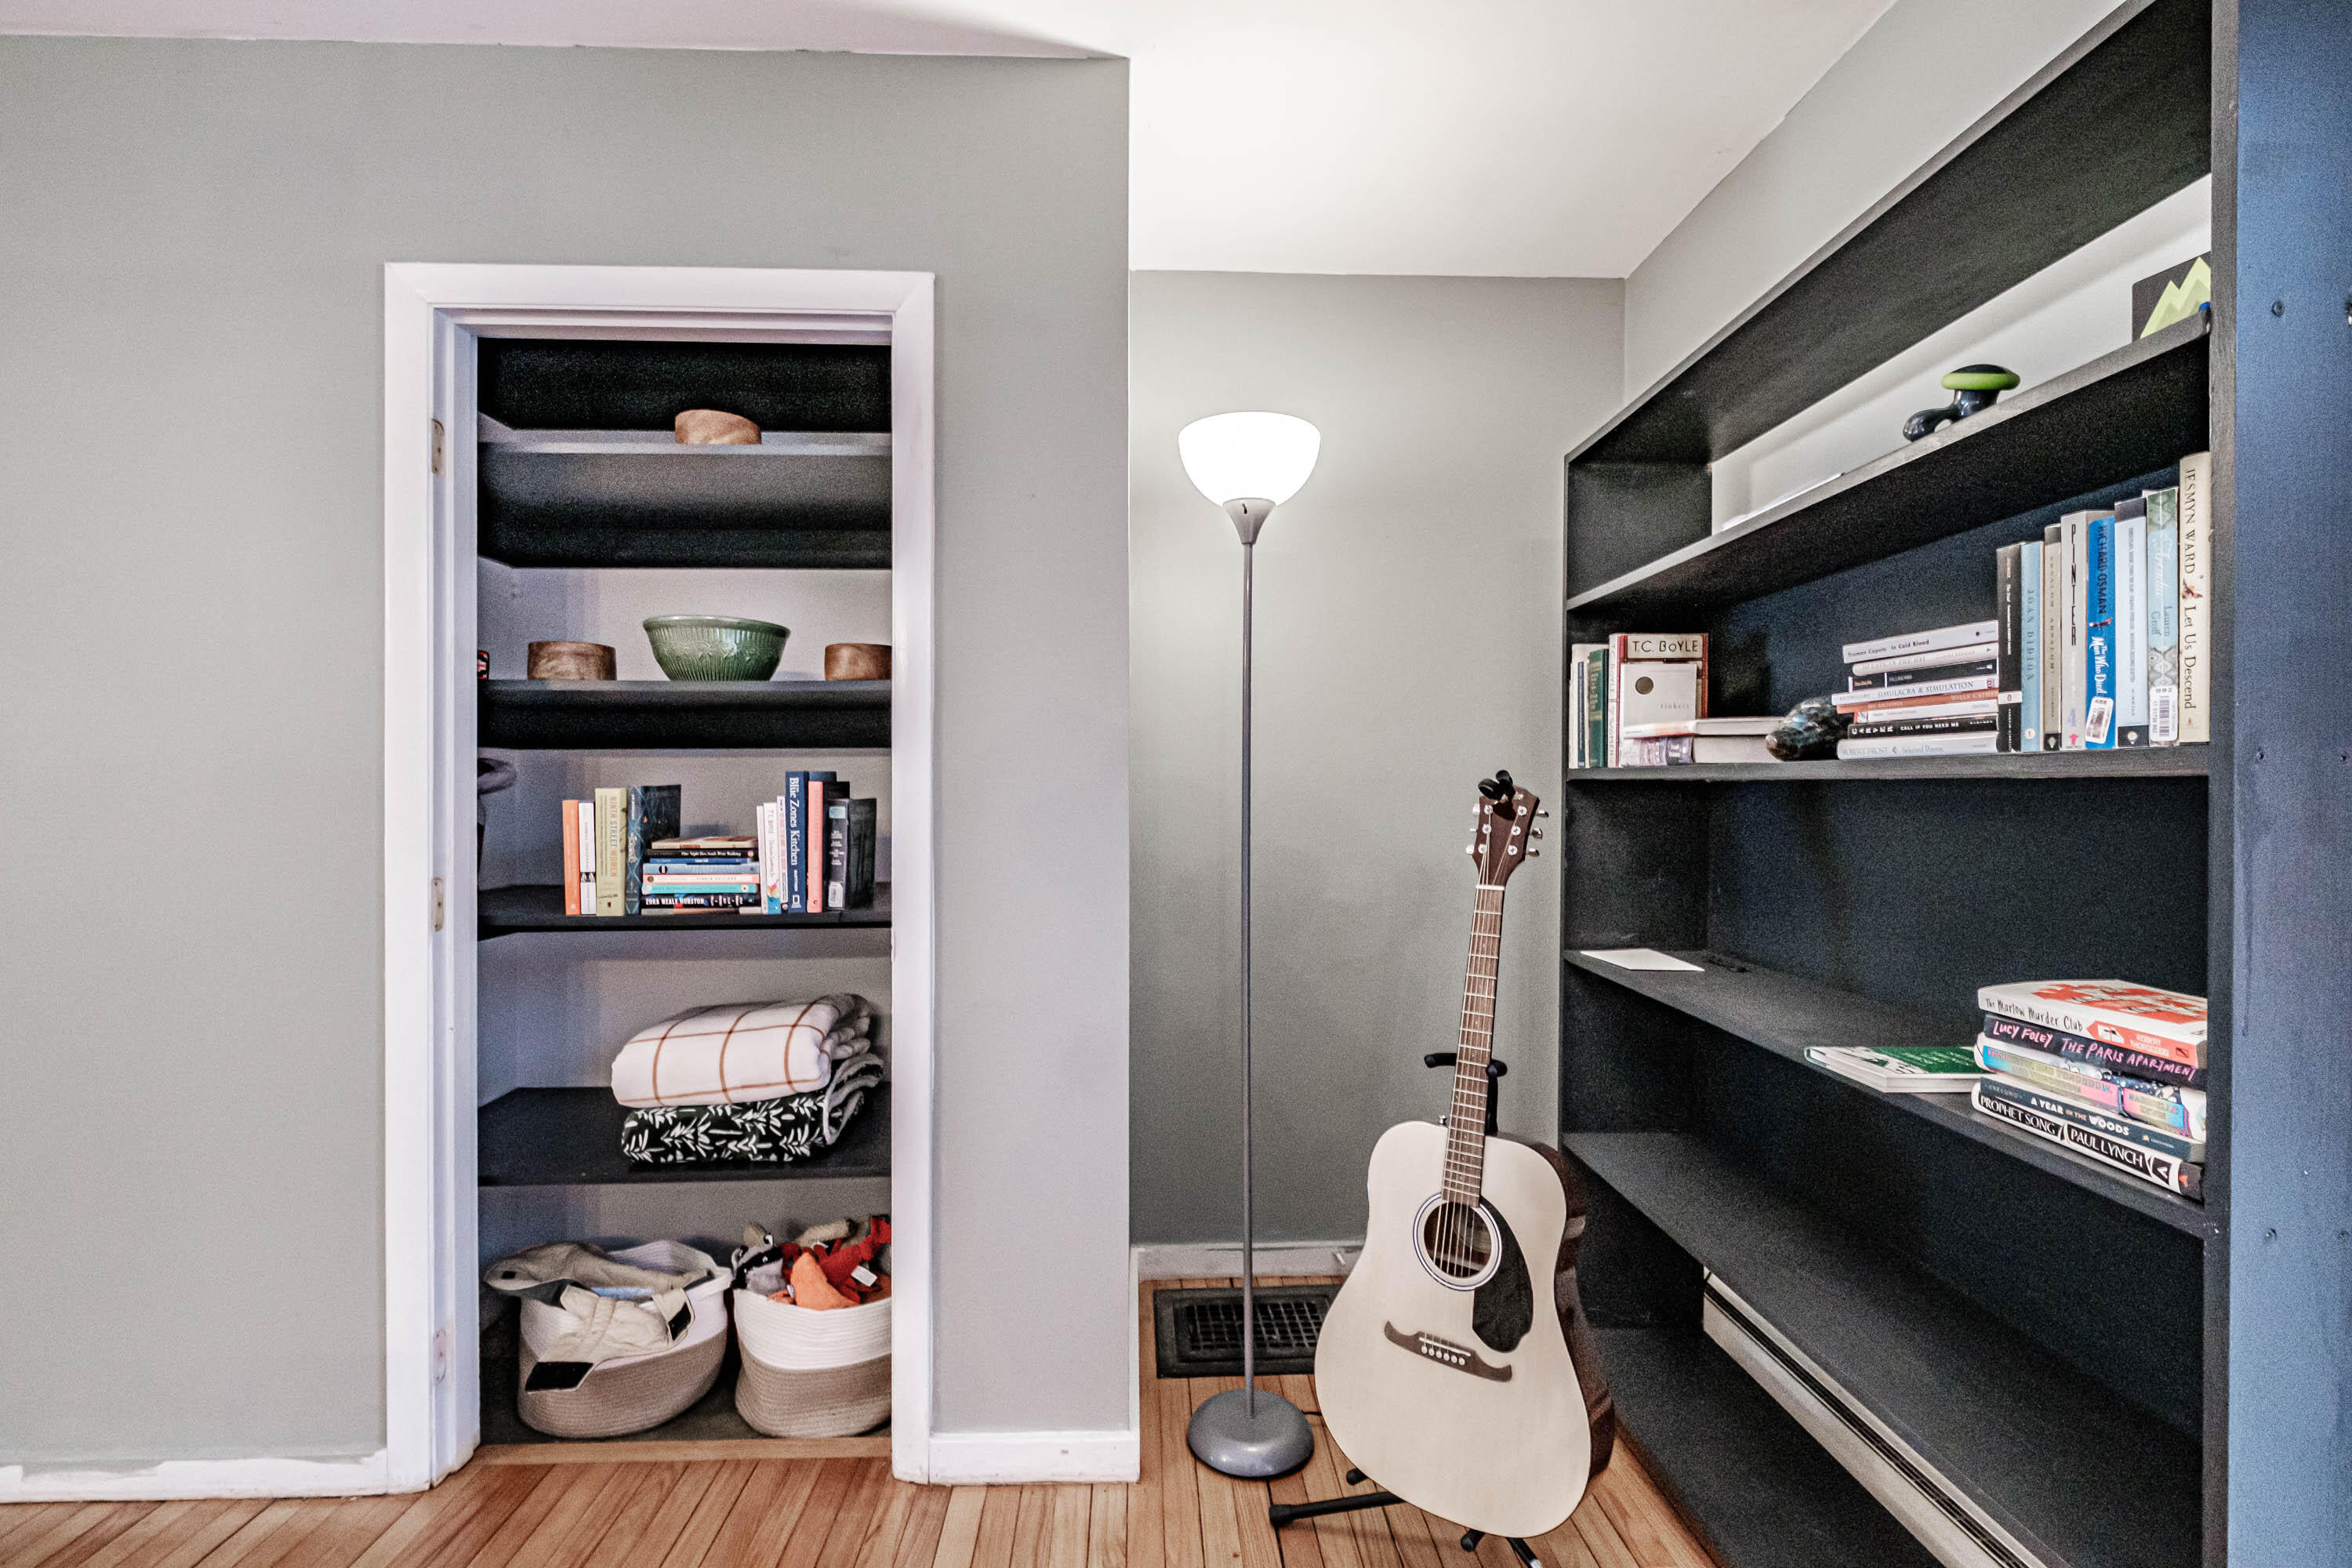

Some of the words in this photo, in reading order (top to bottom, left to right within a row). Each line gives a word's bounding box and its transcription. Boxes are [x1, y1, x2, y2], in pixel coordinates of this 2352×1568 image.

[2184, 469, 2195, 524] JESMYN
[2097, 525, 2107, 572] RICHARD
[2184, 529, 2195, 574] WARD
[2026, 590, 2034, 623] JOAN
[2097, 573, 2107, 615] OSMAN
[2184, 605, 2196, 627] Let
[1632, 641, 1654, 652] T.C.
[1912, 639, 1929, 648] Blood
[2026, 631, 2034, 681] DIDION
[2089, 636, 2104, 655] Man
[2184, 633, 2196, 650] Us
[2094, 655, 2109, 673] Who
[1878, 688, 1916, 699] SIMULACRA
[1926, 681, 1974, 693] SIMULATION
[2094, 673, 2107, 694] Died
[2184, 656, 2196, 709] Descend
[789, 777, 800, 798] Blue
[789, 800, 800, 828] Zones
[790, 829, 800, 866] Kitchen
[1985, 998, 1995, 1008] The
[1997, 999, 2025, 1016] Marlow
[2027, 1007, 2059, 1026] Murder
[2063, 1015, 2083, 1032] Club
[1993, 1021, 2020, 1040] LUCY
[2021, 1029, 2053, 1048] FOLEY
[2062, 1036, 2084, 1054] THE
[2085, 1044, 2123, 1063] PARIS
[2127, 1054, 2196, 1082] APARTMENT
[1981, 1094, 2024, 1119] PROPHET
[2024, 1112, 2056, 1134] SONG
[2031, 1097, 2038, 1106] A
[2040, 1099, 2063, 1115] YEAR
[2074, 1110, 2087, 1121] THE
[2089, 1115, 2129, 1136] WOODS
[2071, 1128, 2100, 1150] PAUL
[2100, 1142, 2143, 1168] LYNCH
